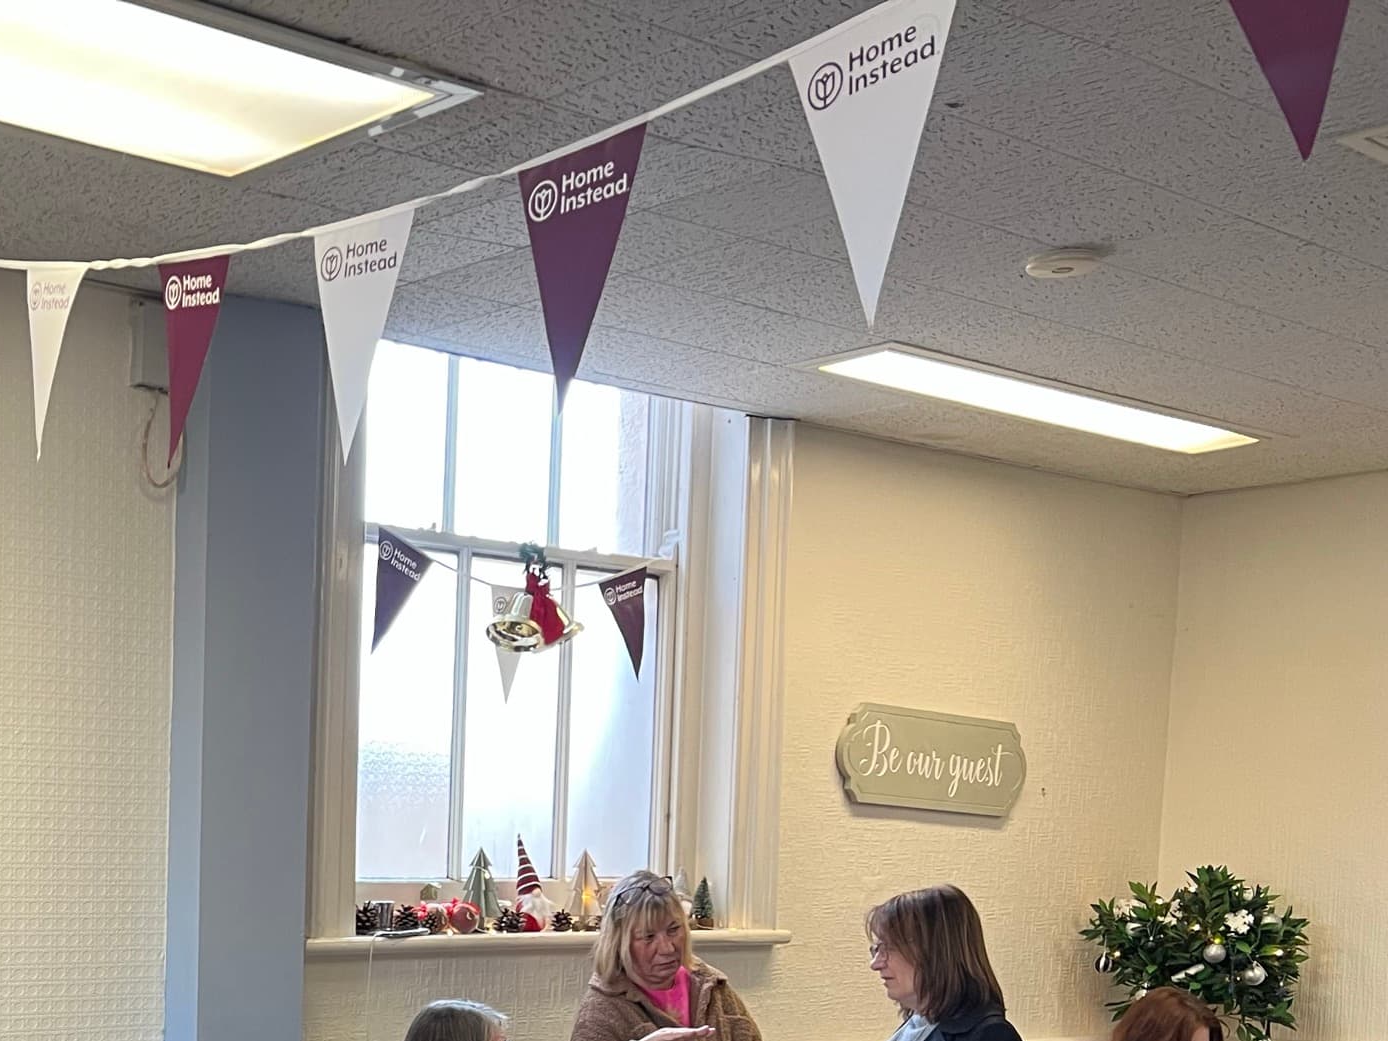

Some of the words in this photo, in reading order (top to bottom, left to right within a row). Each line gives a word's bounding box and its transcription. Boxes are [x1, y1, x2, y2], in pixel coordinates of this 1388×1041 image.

[848, 25, 917, 72] Home
[848, 35, 936, 96] Instead
[561, 161, 615, 193] Home
[559, 172, 628, 215] Instead
[345, 239, 388, 260] Home
[343, 252, 398, 279] Instead
[43, 281, 67, 295] Home
[181, 273, 213, 293] Home
[40, 295, 70, 310] Instead
[181, 287, 221, 308] Instead
[389, 557, 421, 582] Instead
[393, 547, 418, 570] Home
[615, 578, 637, 595] Home
[616, 586, 644, 602] Instead
[859, 719, 903, 777] Be
[905, 750, 946, 780] our
[947, 743, 1014, 798] guest
